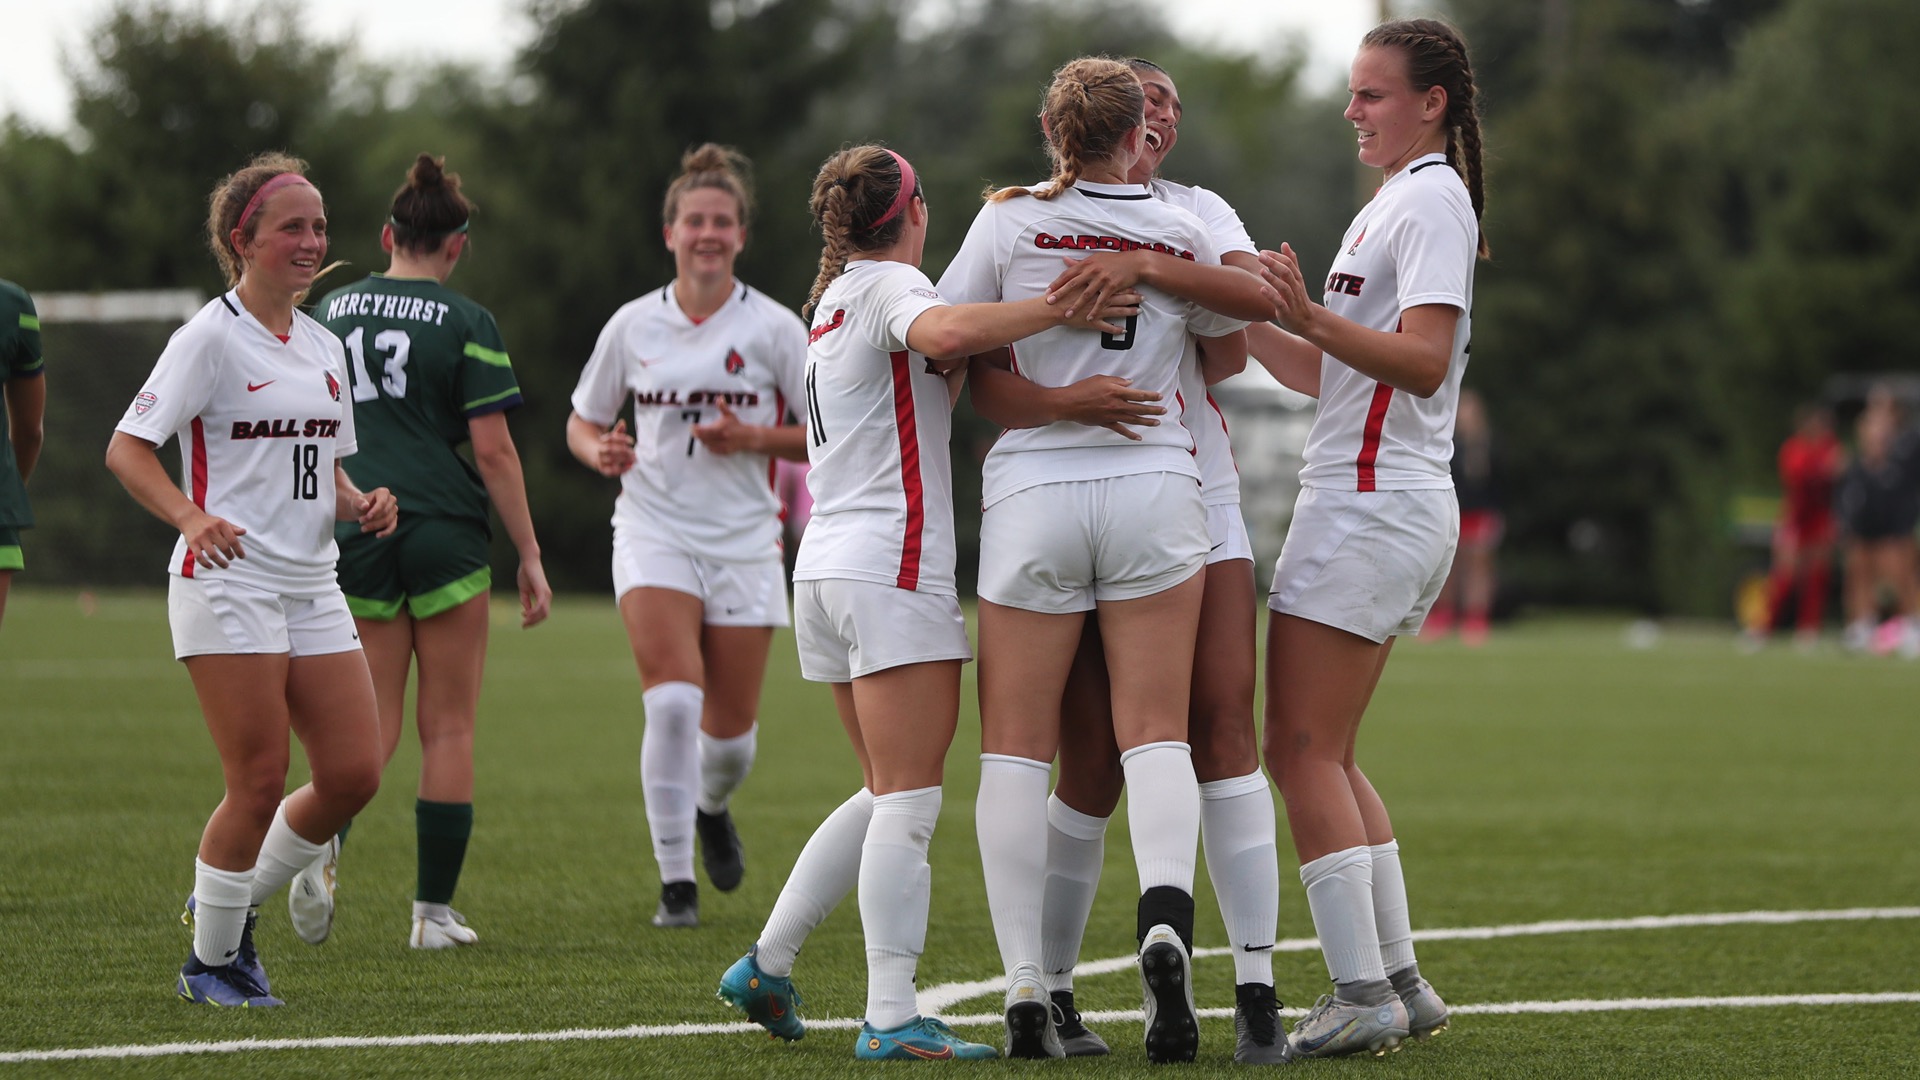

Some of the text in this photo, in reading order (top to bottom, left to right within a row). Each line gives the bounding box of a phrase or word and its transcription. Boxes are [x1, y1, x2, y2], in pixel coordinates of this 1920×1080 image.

[326, 292, 449, 326] MERCYHURST
[345, 326, 411, 404] 13
[230, 419, 300, 440] BALL
[805, 361, 827, 448] 11
[682, 409, 701, 457] 7
[292, 444, 318, 500] 18
